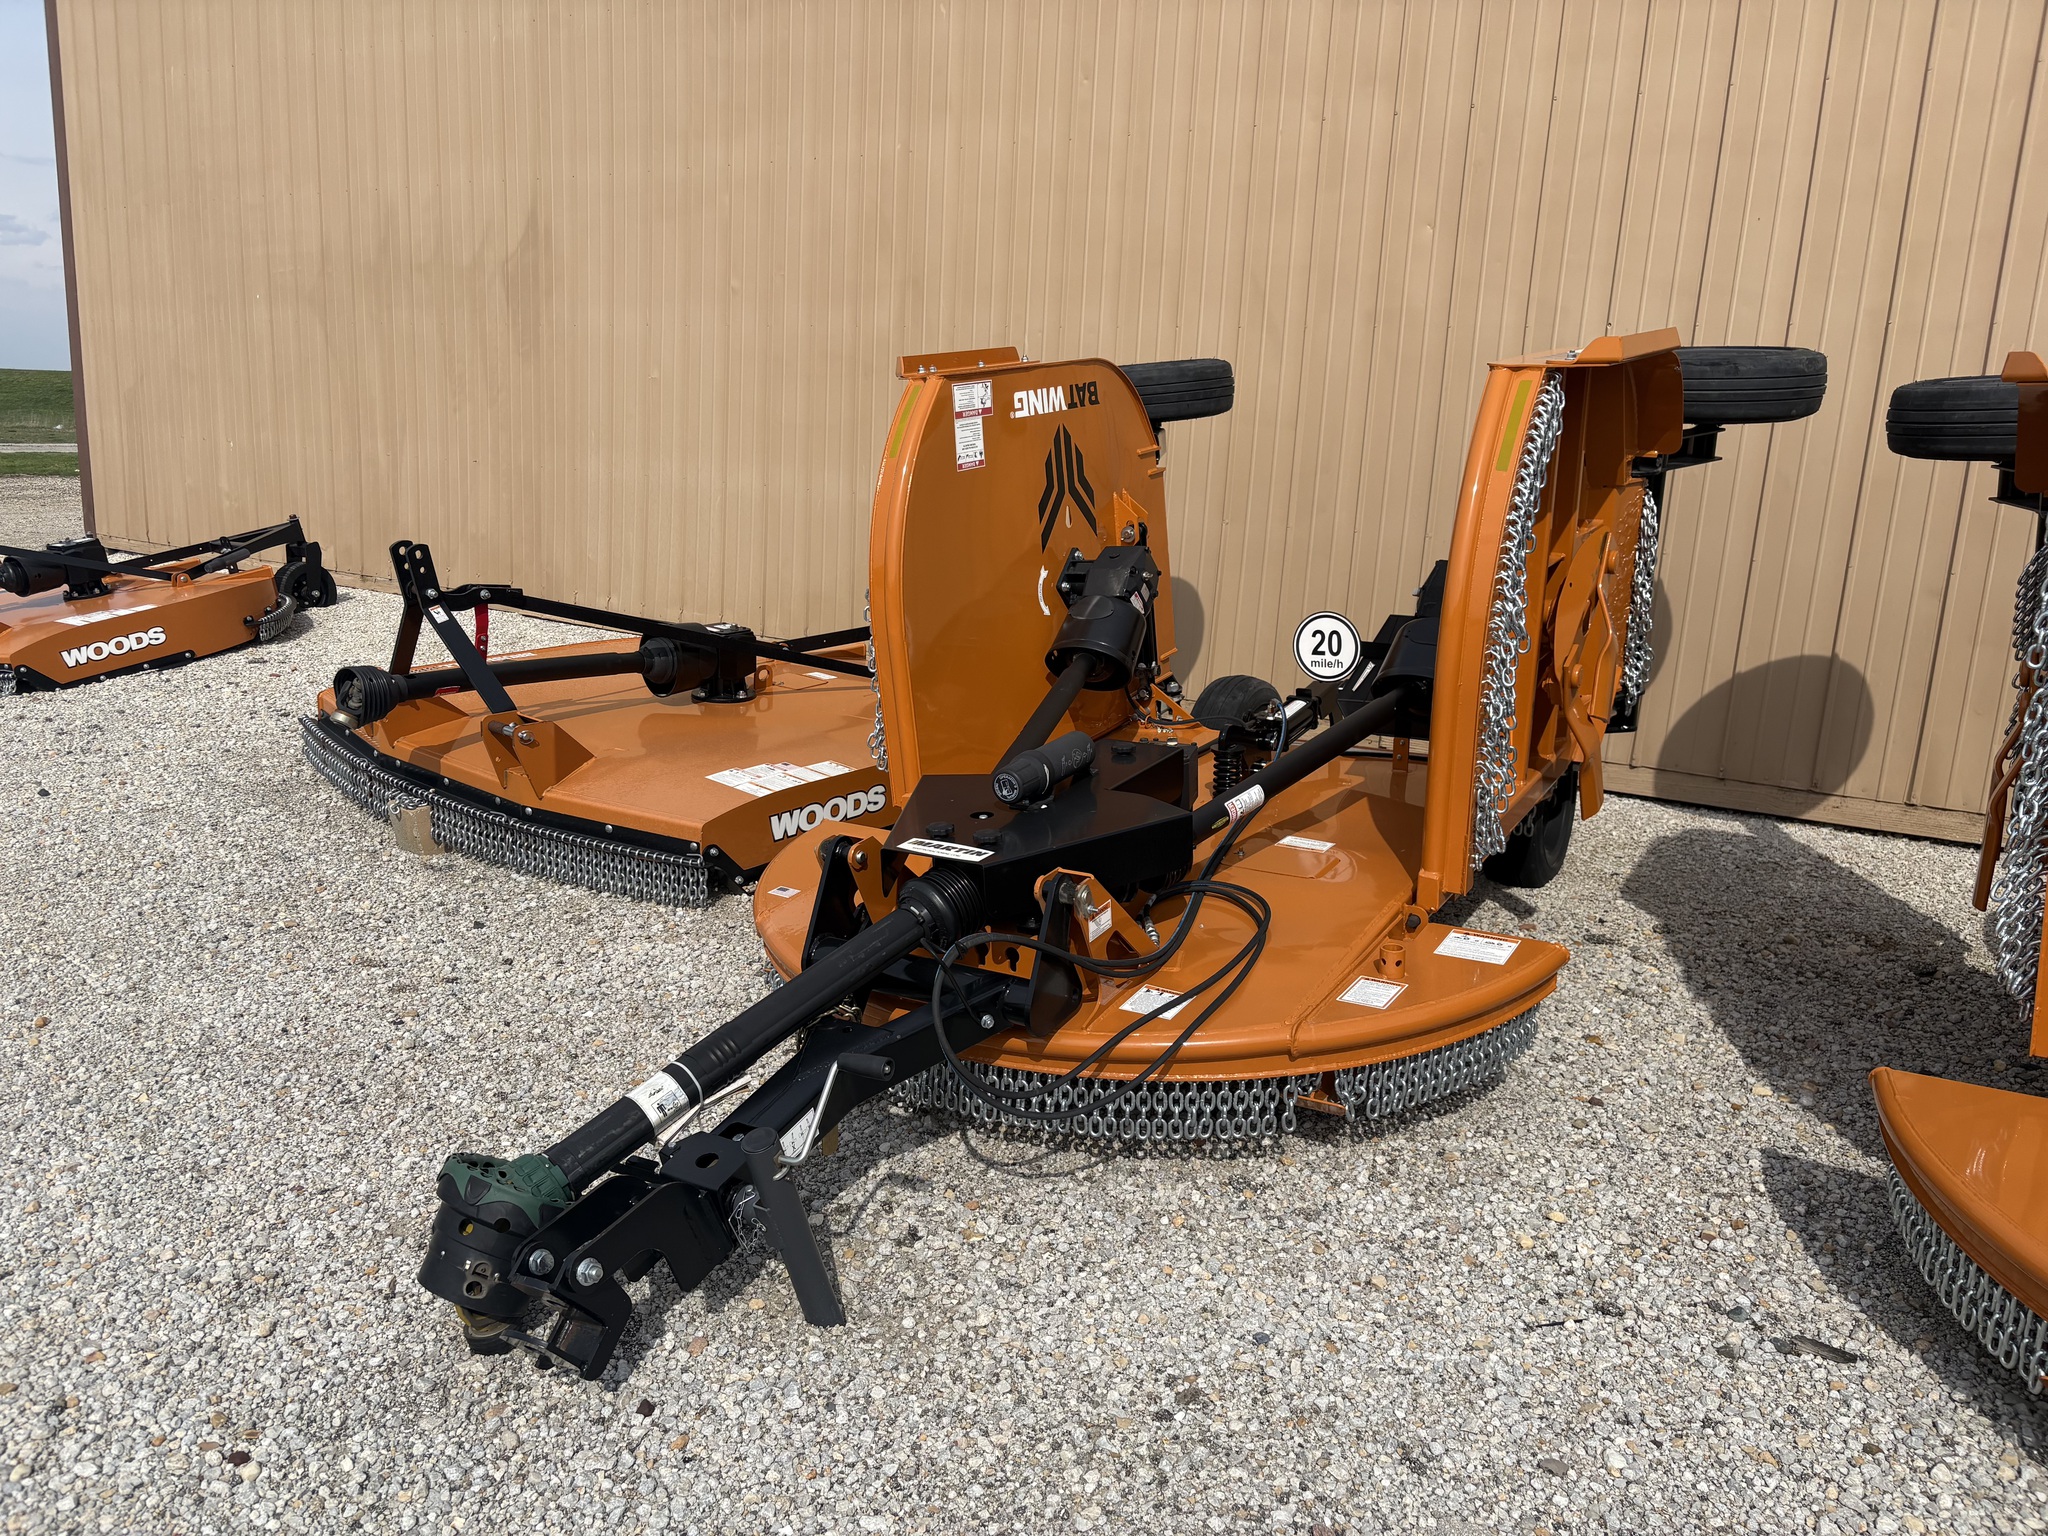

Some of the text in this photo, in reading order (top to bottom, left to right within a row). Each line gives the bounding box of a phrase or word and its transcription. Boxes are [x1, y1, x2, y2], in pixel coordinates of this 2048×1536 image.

[60, 626, 167, 668] WOODS
[1311, 629, 1342, 656] 20
[1310, 659, 1344, 669] mile/h
[769, 784, 887, 842] WOODS
[911, 840, 989, 857] MARTIN
